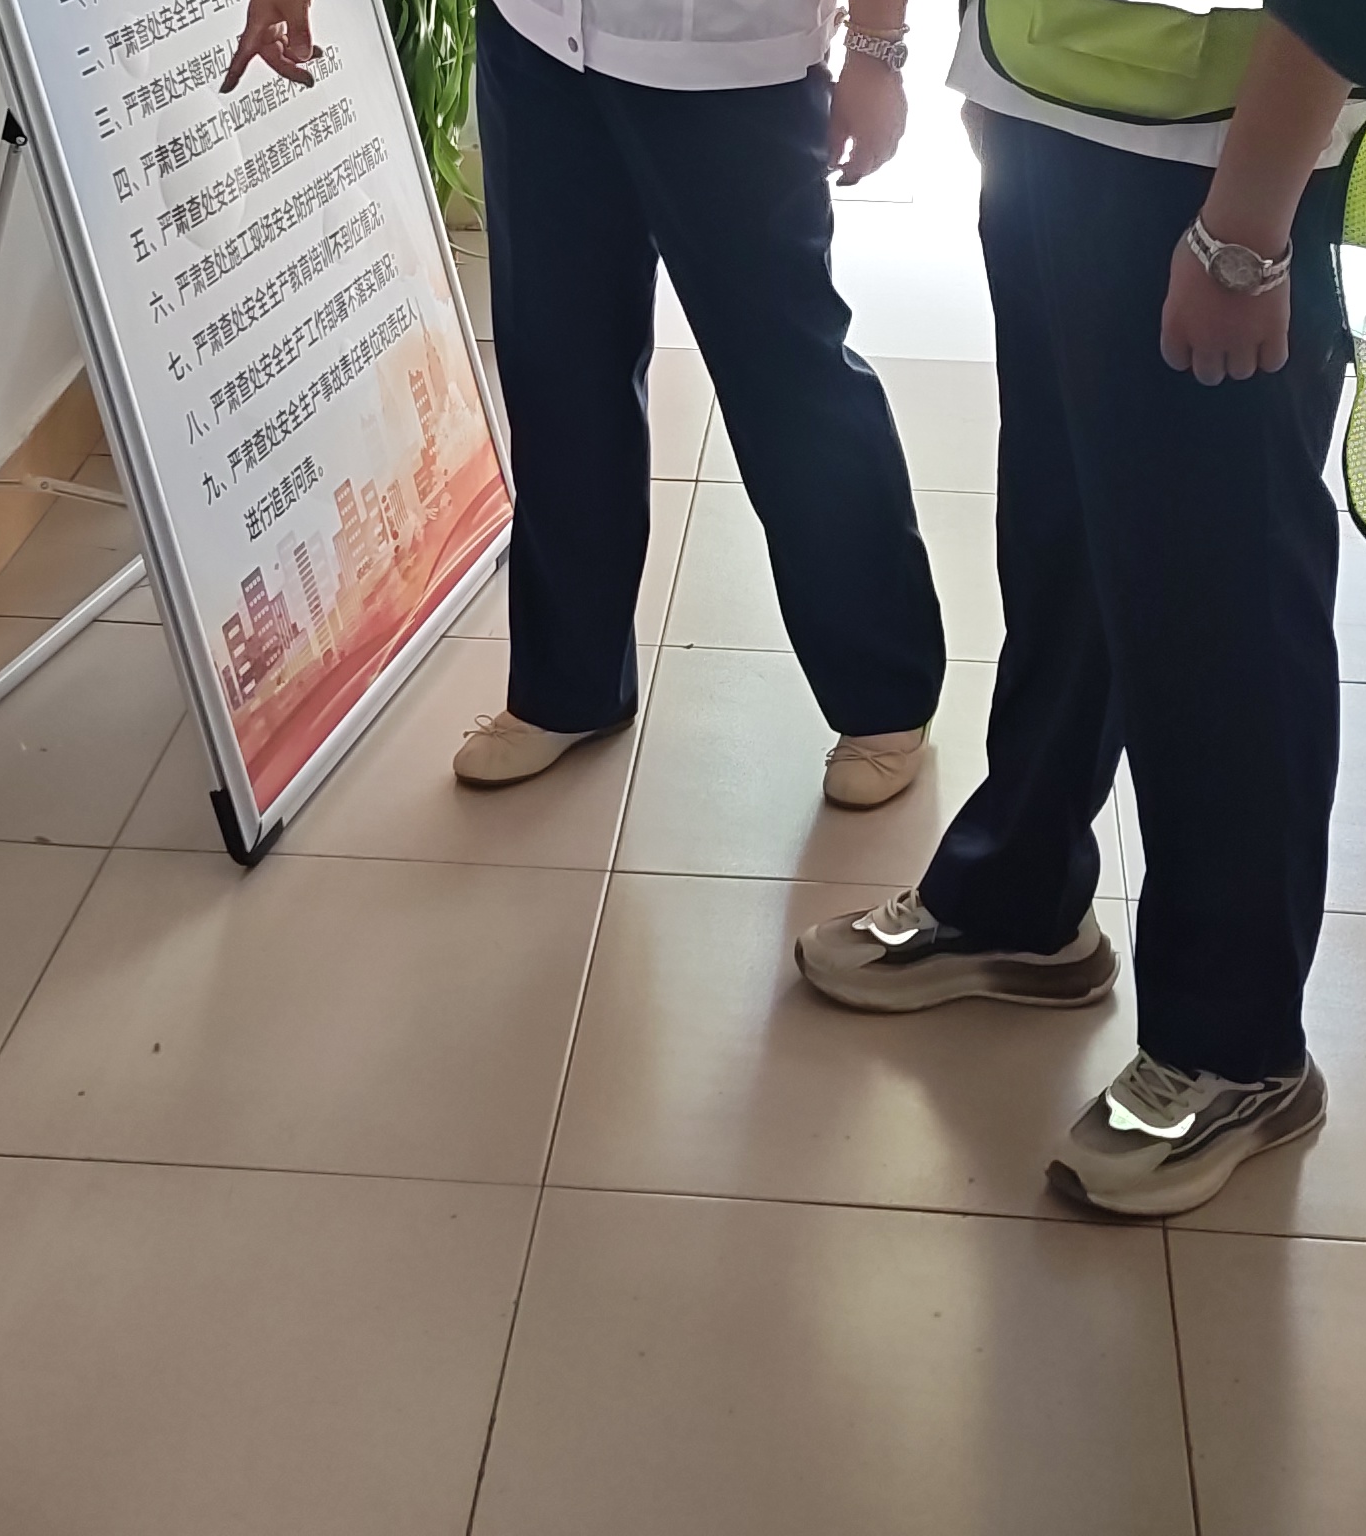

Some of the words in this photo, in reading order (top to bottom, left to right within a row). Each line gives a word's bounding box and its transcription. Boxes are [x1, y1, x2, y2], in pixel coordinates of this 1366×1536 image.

[95, 34, 243, 139] 三、严肃查处关键岗位人
[112, 45, 344, 204] 四、严肃查处施工作业现场管控不位情况；
